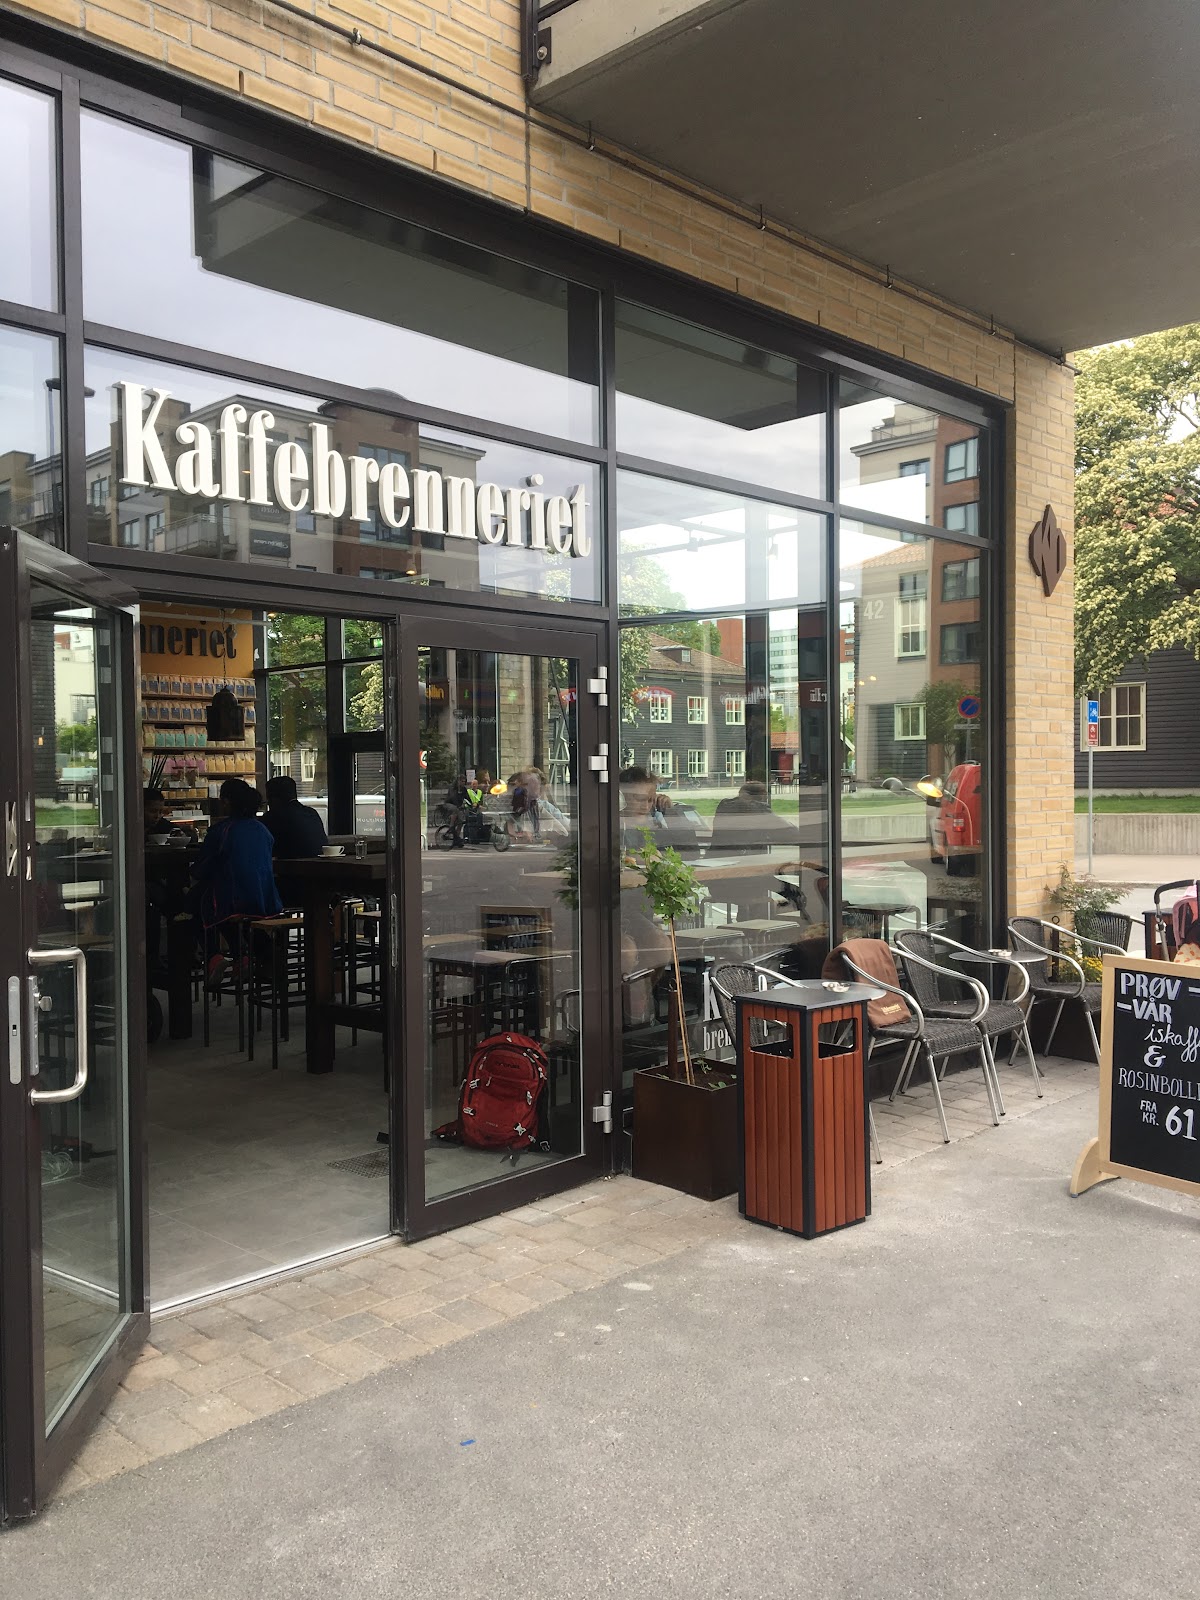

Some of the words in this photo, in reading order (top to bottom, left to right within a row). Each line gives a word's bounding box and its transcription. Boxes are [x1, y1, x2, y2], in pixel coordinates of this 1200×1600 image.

[114, 380, 592, 557] Kaffebrenneriet
[863, 599, 885, 620] 42
[1121, 972, 1182, 1001] PRØV
[1143, 1023, 1200, 1063] iskaff
[1140, 1100, 1158, 1113] FRA
[1142, 1112, 1160, 1126] KR.
[1165, 1105, 1198, 1141] 61
